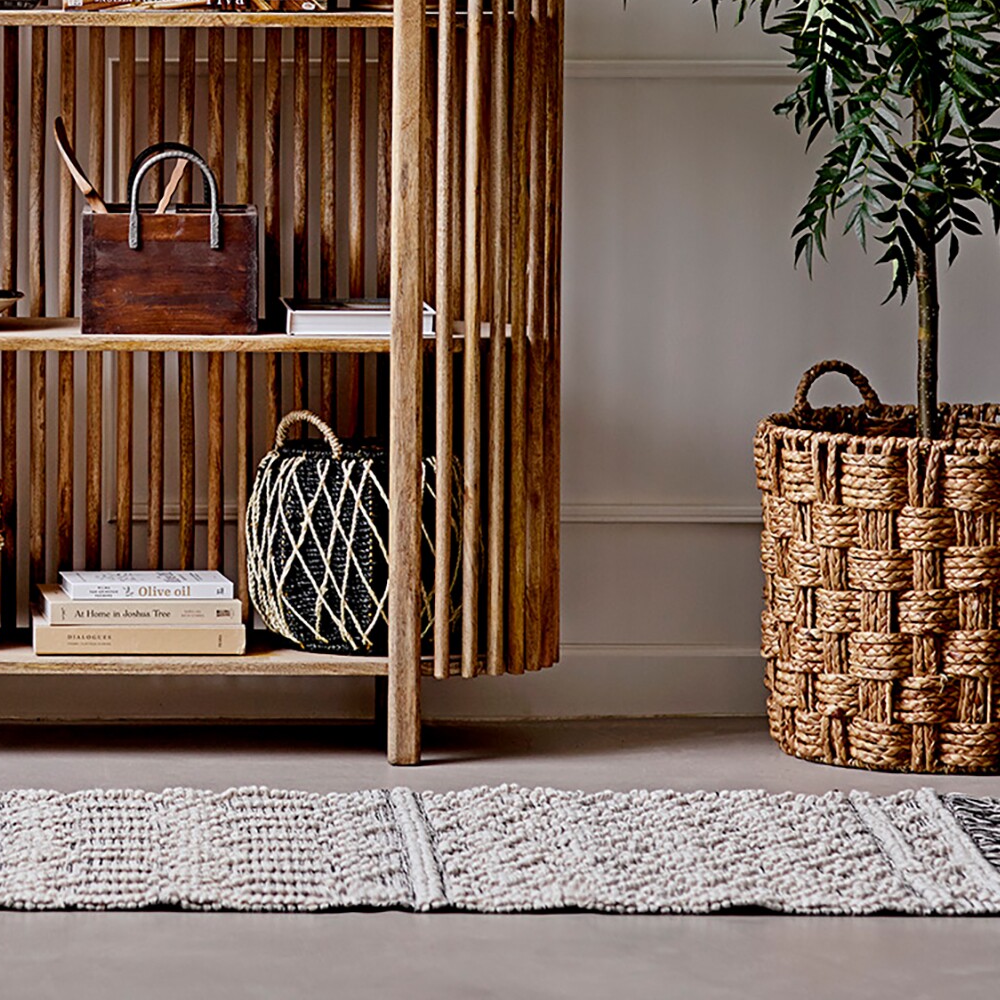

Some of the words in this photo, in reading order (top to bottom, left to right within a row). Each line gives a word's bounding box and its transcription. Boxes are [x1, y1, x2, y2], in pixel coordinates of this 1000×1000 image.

[138, 586, 171, 597] Olive
[173, 585, 191, 597] oil
[74, 609, 84, 618] At
[86, 609, 111, 618] Home
[113, 609, 121, 618] in
[122, 609, 150, 618] Joshua
[151, 609, 171, 618] Tree
